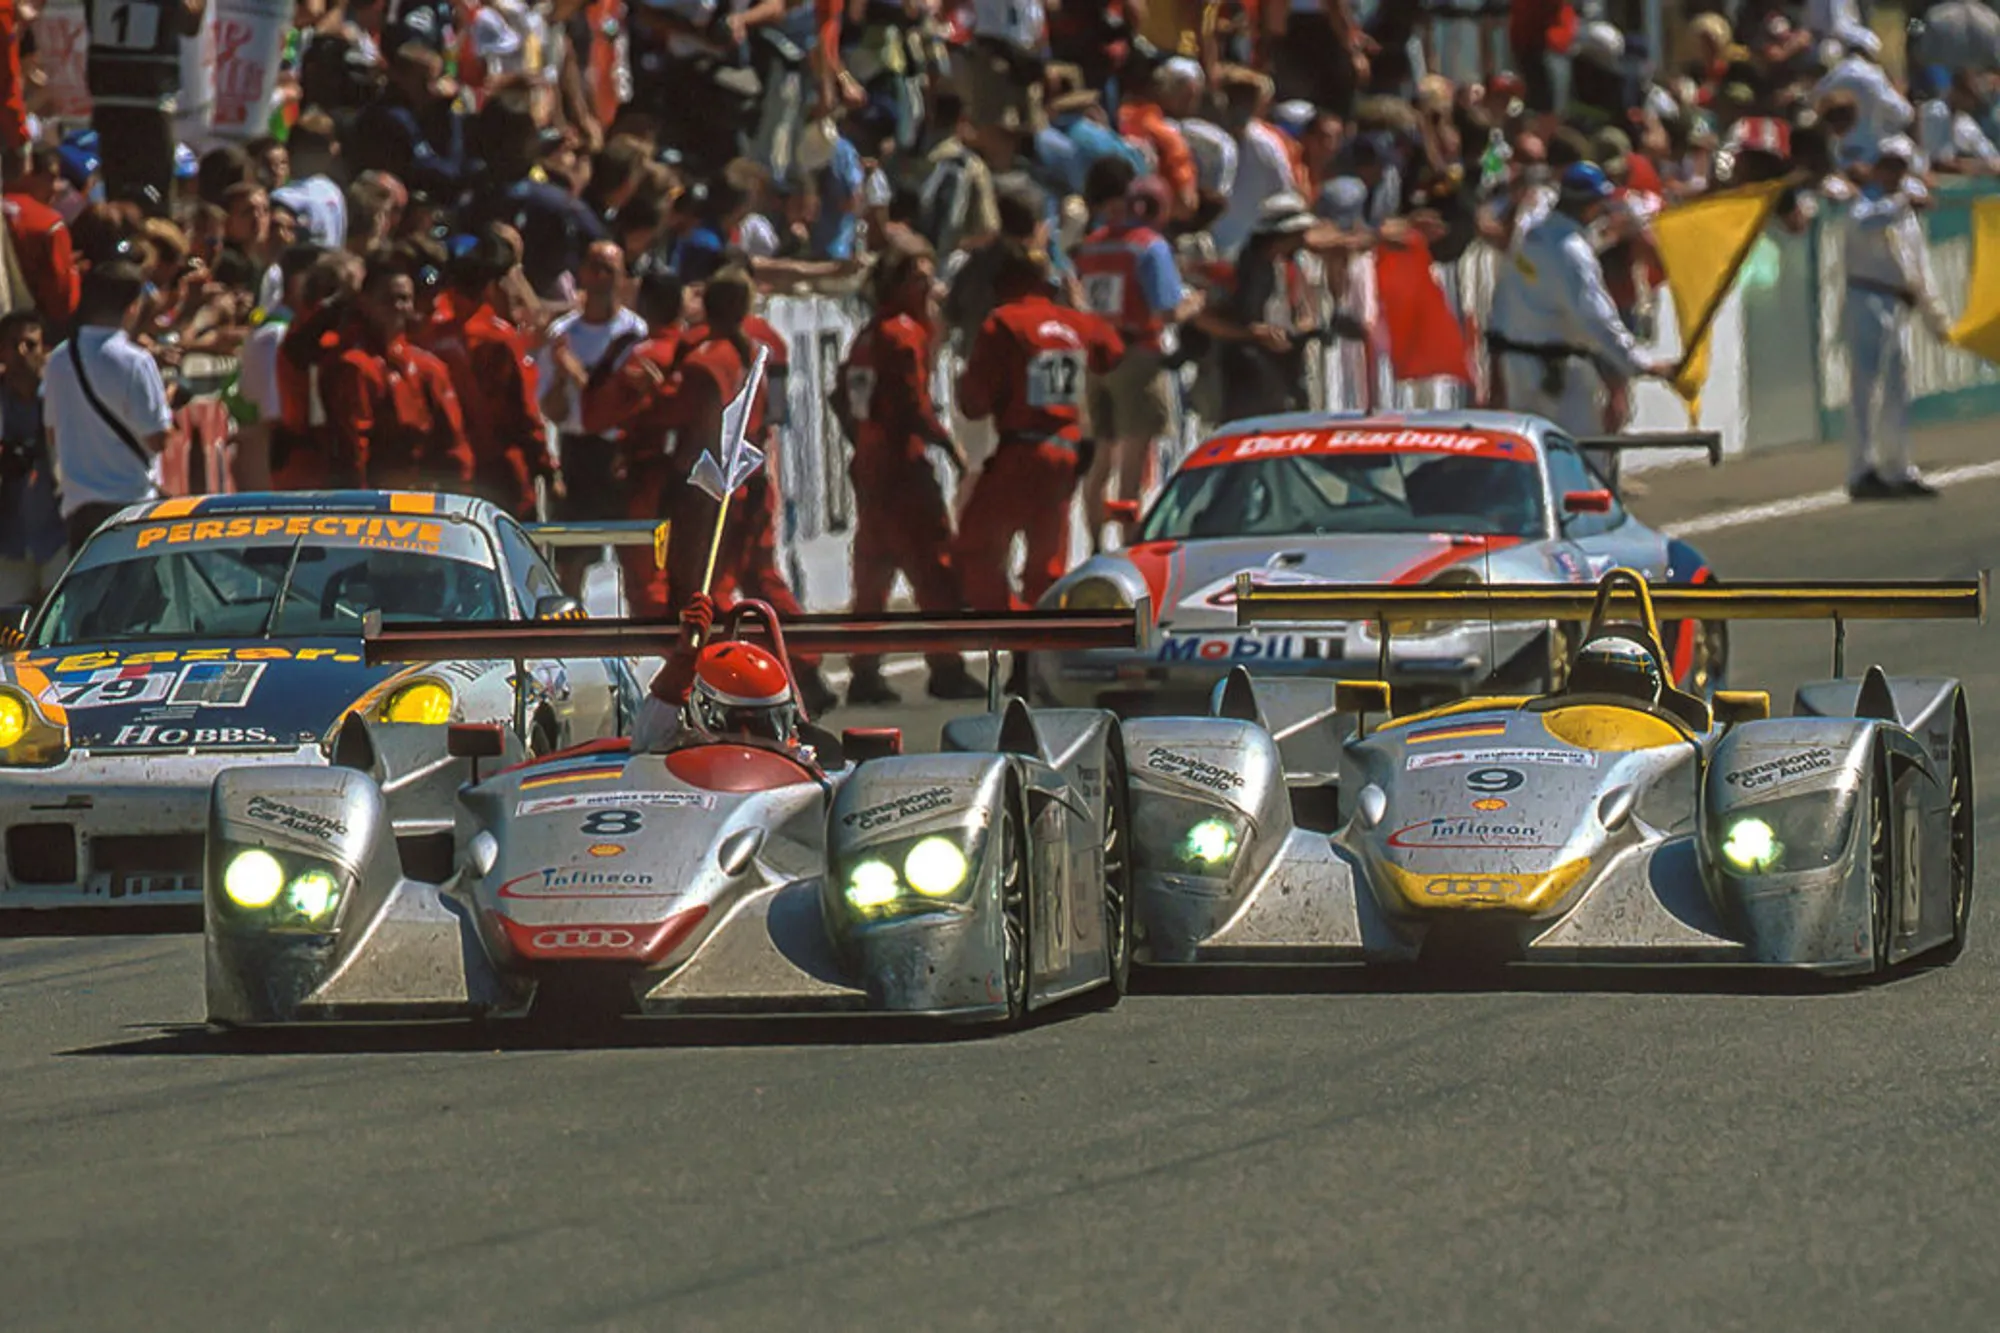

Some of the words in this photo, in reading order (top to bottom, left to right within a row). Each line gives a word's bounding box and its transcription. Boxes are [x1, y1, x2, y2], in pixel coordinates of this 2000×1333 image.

[137, 517, 443, 548] PERSPECTIVE
[1156, 634, 1292, 661] Mobil
[57, 676, 152, 704] 79
[1149, 747, 1245, 787] Panasonic
[1149, 759, 1181, 772] Car
[1181, 769, 1229, 791] Audio
[1466, 768, 1524, 793] 9
[1725, 748, 1832, 785] Panasonic
[1742, 774, 1773, 788] Car
[1780, 758, 1832, 777] Audio
[247, 796, 348, 835] Panasonic
[842, 786, 952, 825] Panasonic
[860, 813, 891, 830] Car
[900, 796, 952, 818] Audio
[247, 806, 279, 820] Car
[280, 817, 331, 839] Audio
[580, 809, 643, 834] 8
[1431, 818, 1538, 838] Infineon
